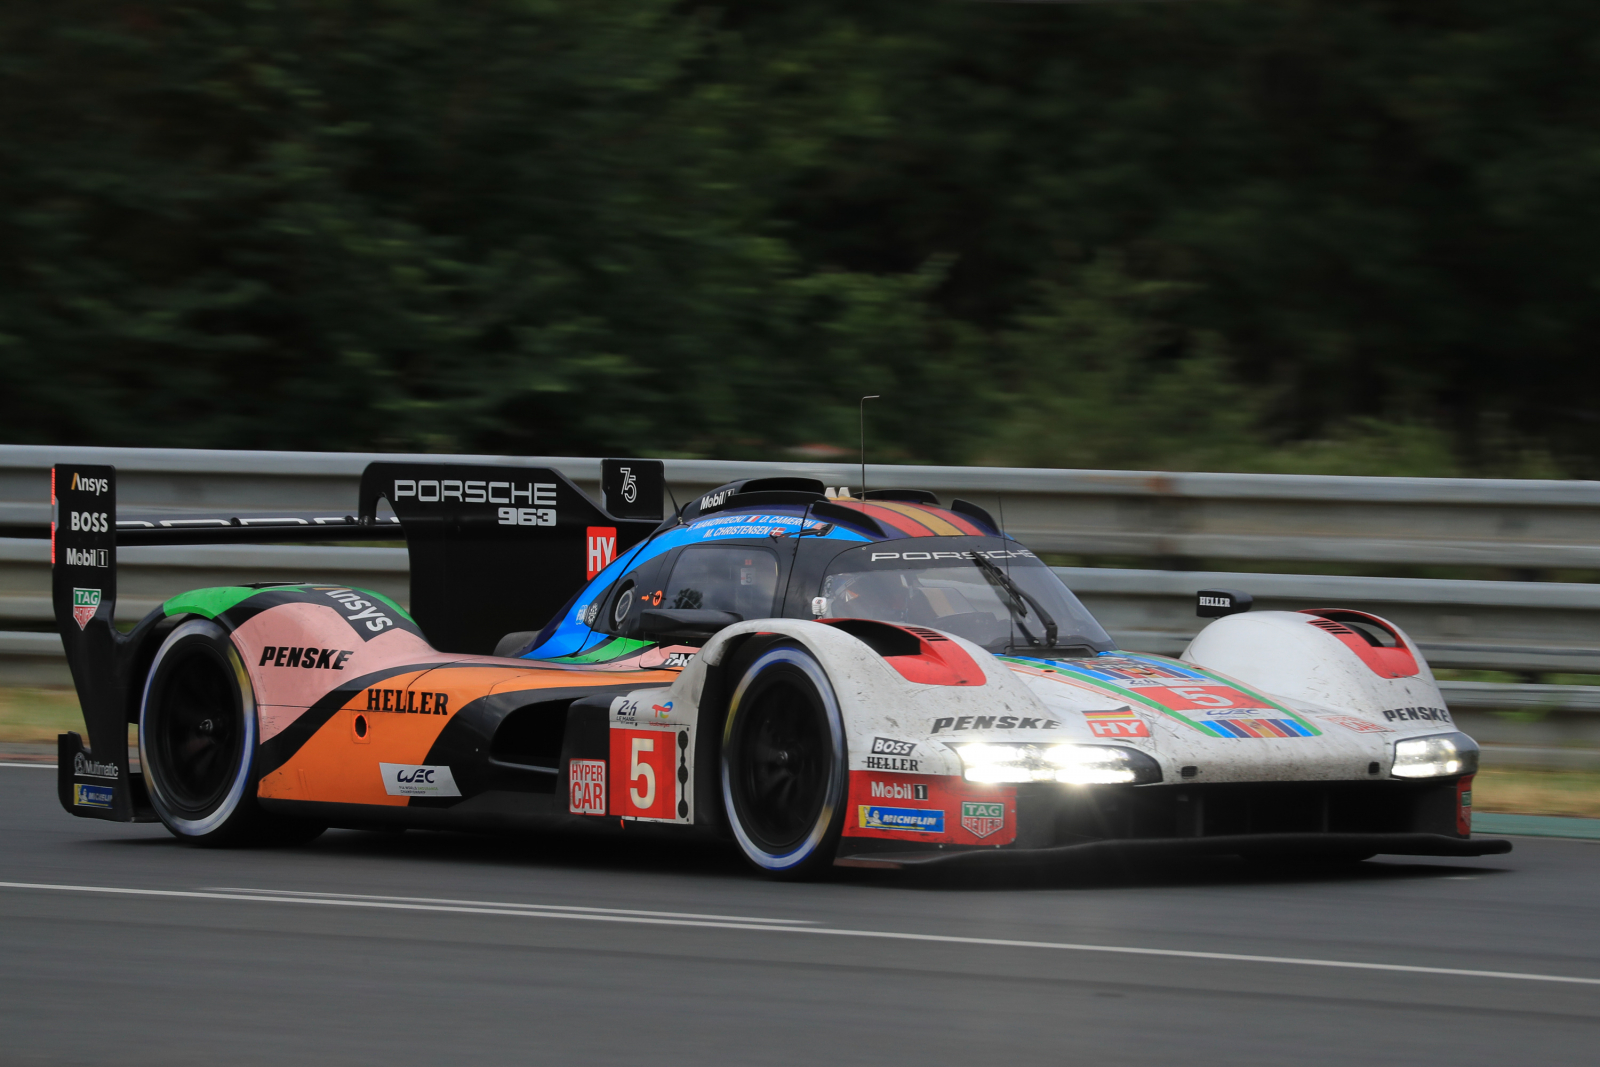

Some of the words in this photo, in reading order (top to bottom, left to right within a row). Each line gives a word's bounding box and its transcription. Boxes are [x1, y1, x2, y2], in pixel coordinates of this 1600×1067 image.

[71, 472, 108, 496] Ansys
[394, 479, 557, 505] PORSCHE
[700, 491, 725, 511] Mobil
[71, 511, 108, 533] BOSS
[498, 507, 557, 526] 963
[759, 515, 767, 523] D.
[769, 516, 816, 528] CAMERON
[703, 528, 713, 538] M.
[713, 526, 772, 537] CHRISTENSEN
[66, 547, 96, 567] Mobil
[97, 548, 108, 567] 1
[588, 536, 615, 571] HY
[871, 549, 1037, 562] PORSCHE
[75, 591, 99, 604] TAG
[1199, 596, 1231, 608] HELLER
[312, 587, 393, 632] Ansys
[259, 645, 354, 671] PENSKE
[367, 688, 449, 716] HELLER
[1166, 687, 1234, 707] 5
[1382, 706, 1451, 724] PENSKE
[930, 715, 1062, 735] PENSKE
[1092, 721, 1141, 735] HY
[874, 739, 913, 755] BOSS
[571, 764, 603, 782] HYPER
[629, 737, 656, 810] 5
[867, 756, 919, 772] HELLER
[396, 768, 435, 784] WEC
[571, 782, 603, 811] CAR
[871, 781, 911, 799] Mobil
[914, 784, 928, 801] 1
[882, 814, 937, 826] MICHELIN
[965, 805, 1000, 816] TAG
[964, 818, 1001, 835] HEUER
